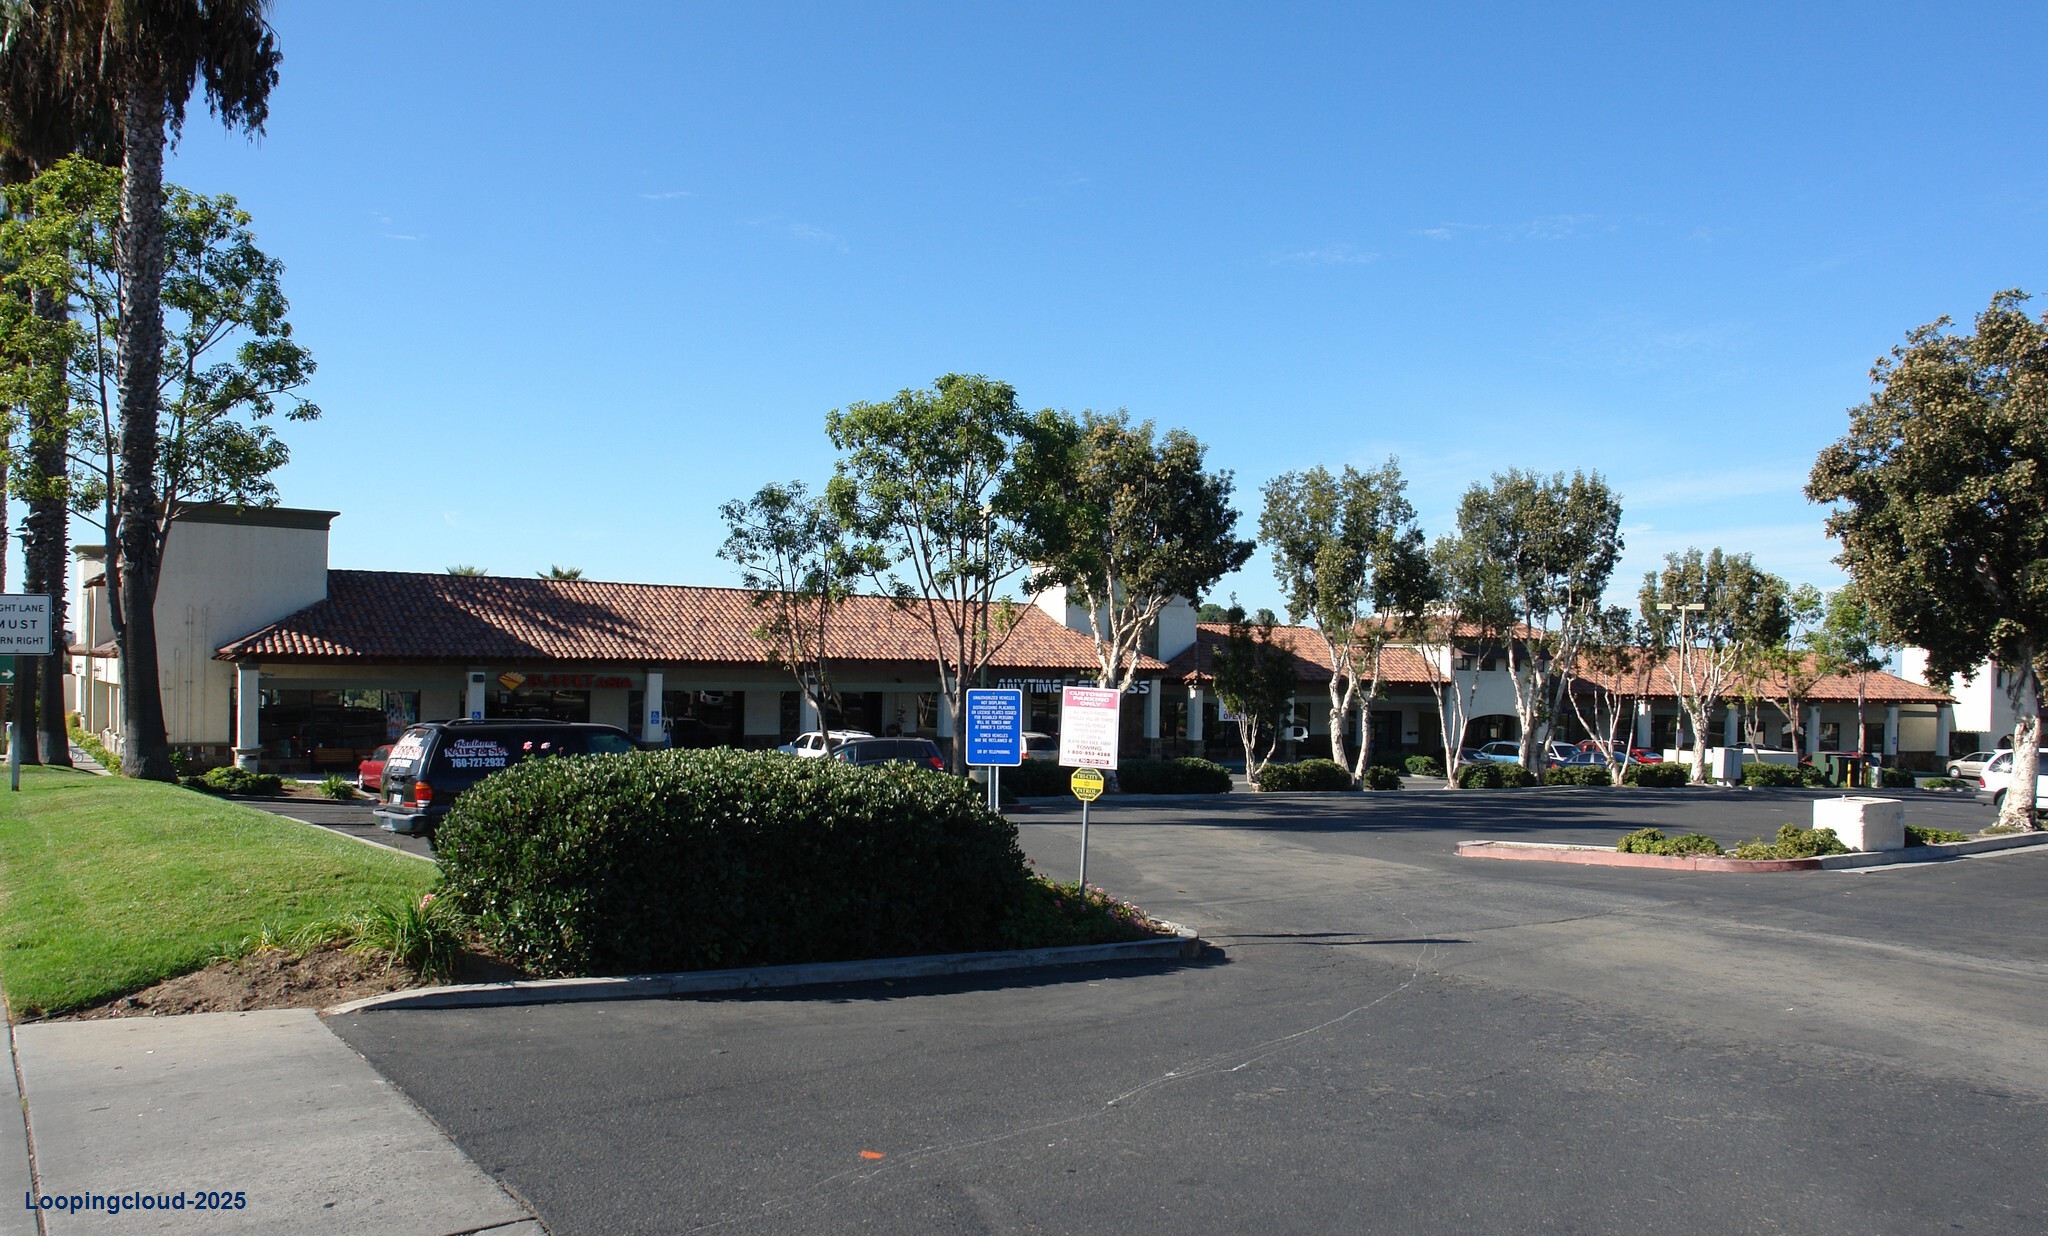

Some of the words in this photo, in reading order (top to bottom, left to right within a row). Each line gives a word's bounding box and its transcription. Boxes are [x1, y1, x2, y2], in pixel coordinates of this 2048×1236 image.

[16, 637, 44, 645] RIGHT
[595, 677, 633, 688] ASIA
[996, 679, 1061, 693] ANYTIME
[444, 747, 476, 757] NAILS
[478, 748, 488, 757] &
[488, 748, 509, 757] SPA
[451, 758, 506, 768] 760-727-2932
